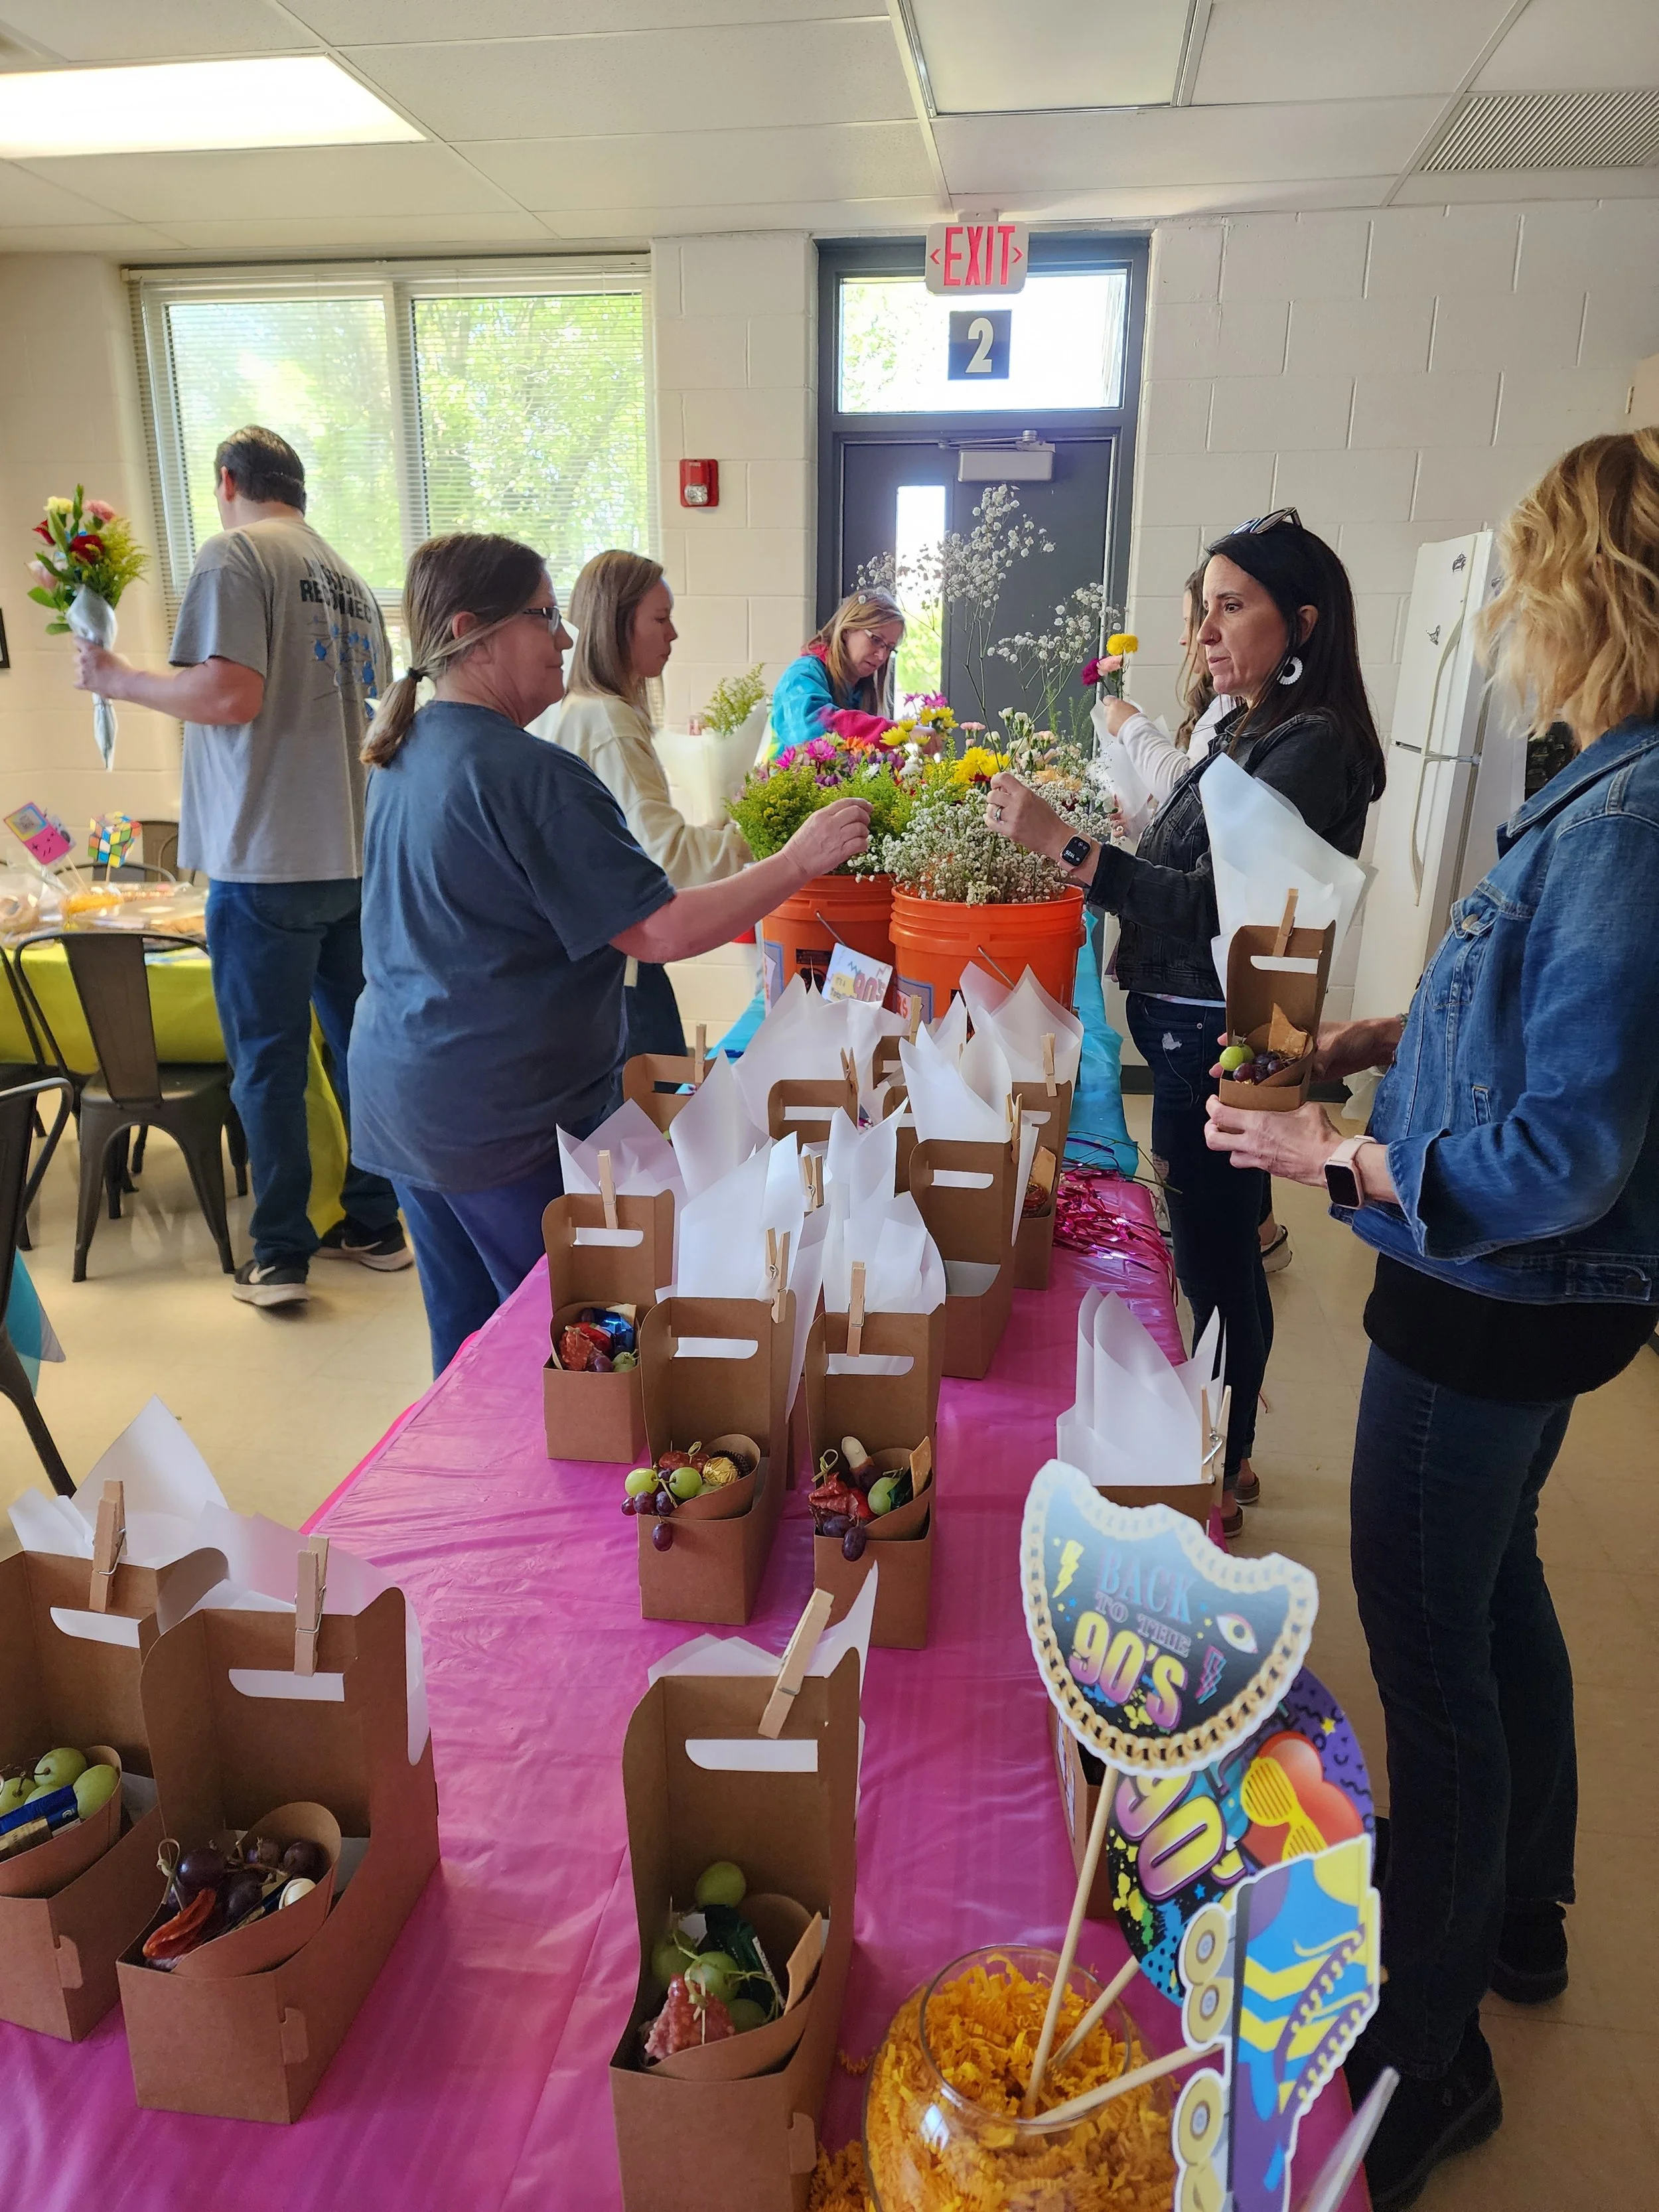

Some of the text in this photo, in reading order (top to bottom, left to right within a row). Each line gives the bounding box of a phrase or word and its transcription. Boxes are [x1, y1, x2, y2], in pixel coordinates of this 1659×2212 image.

[943, 225, 1016, 286] EXIT
[964, 317, 994, 374] 2
[1096, 1547, 1196, 1625] BACK
[1094, 1592, 1192, 1659] TO THE
[1068, 1611, 1189, 1730] 90'S
